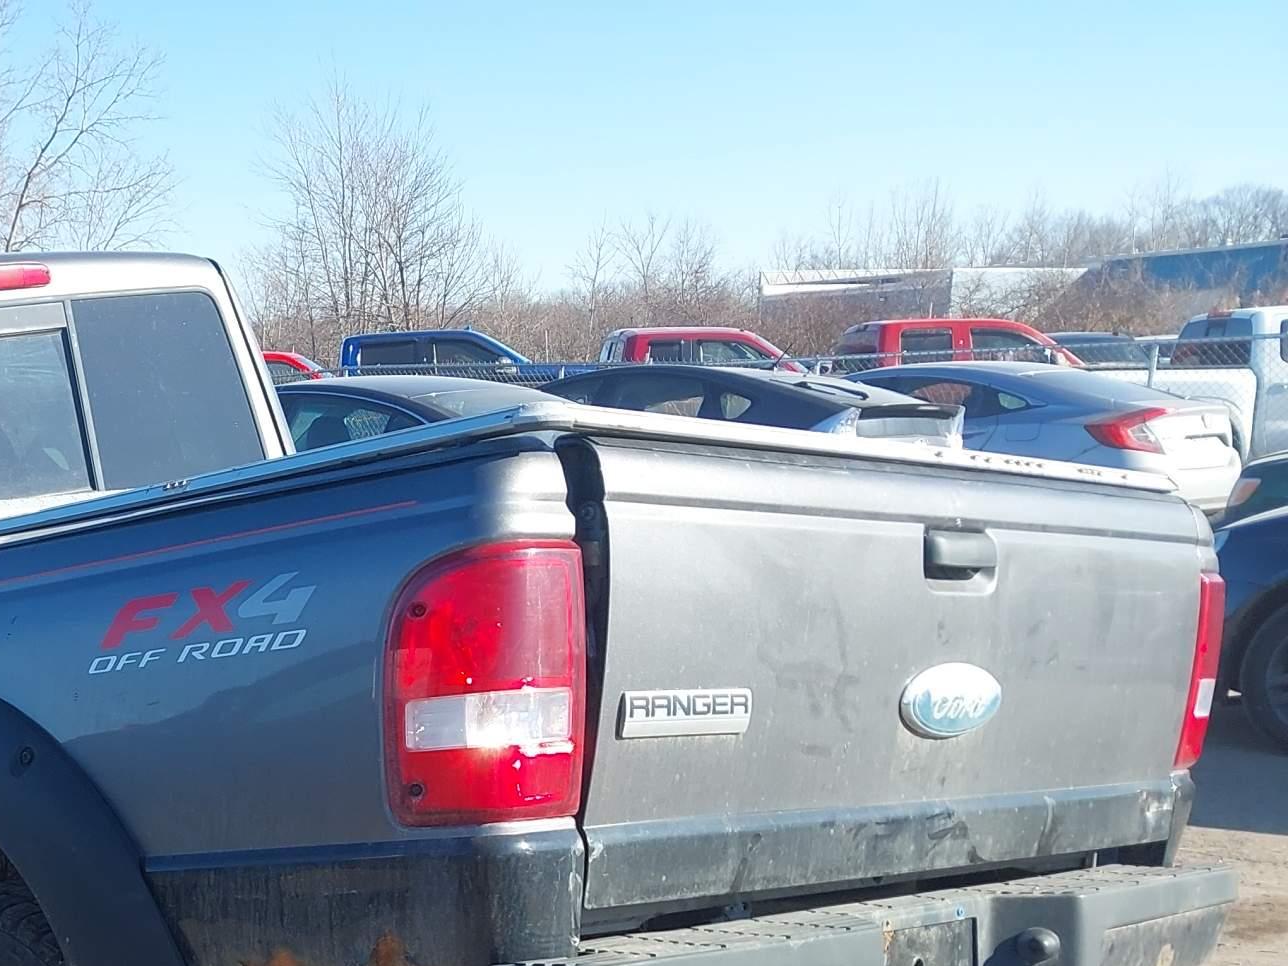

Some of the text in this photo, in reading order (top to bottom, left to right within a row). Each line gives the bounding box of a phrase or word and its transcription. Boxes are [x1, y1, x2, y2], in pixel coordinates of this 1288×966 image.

[100, 571, 317, 650] FX4
[88, 629, 307, 675] OFF ROAD
[628, 693, 749, 719] RANGER
